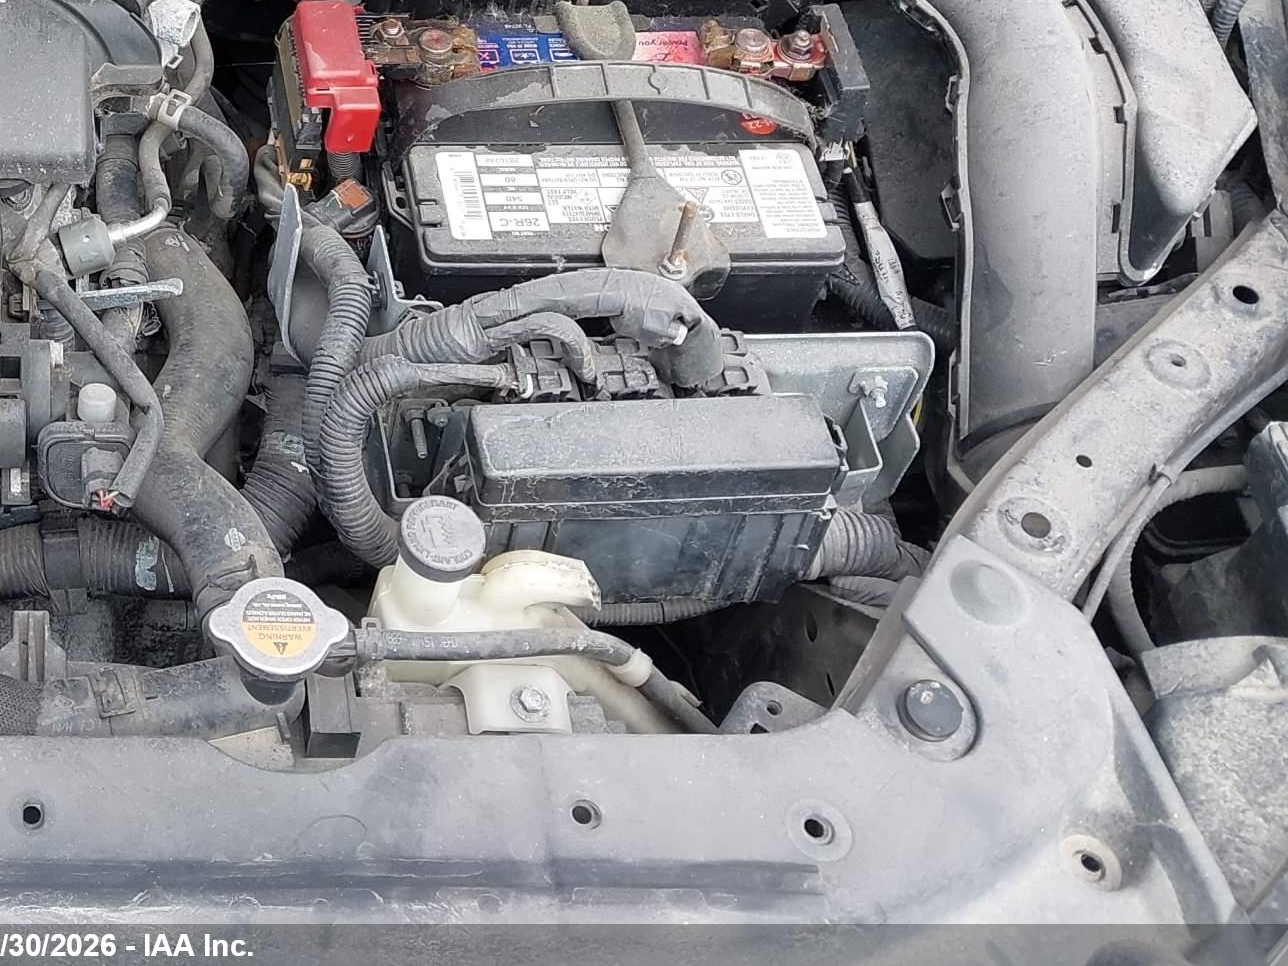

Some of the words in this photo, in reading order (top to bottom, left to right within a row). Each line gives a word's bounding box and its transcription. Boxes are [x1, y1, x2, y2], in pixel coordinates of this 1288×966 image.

[499, 217, 541, 227] 26R-C
[247, 623, 312, 631] AVERTISSEMENT
[258, 632, 303, 641] WARNING
